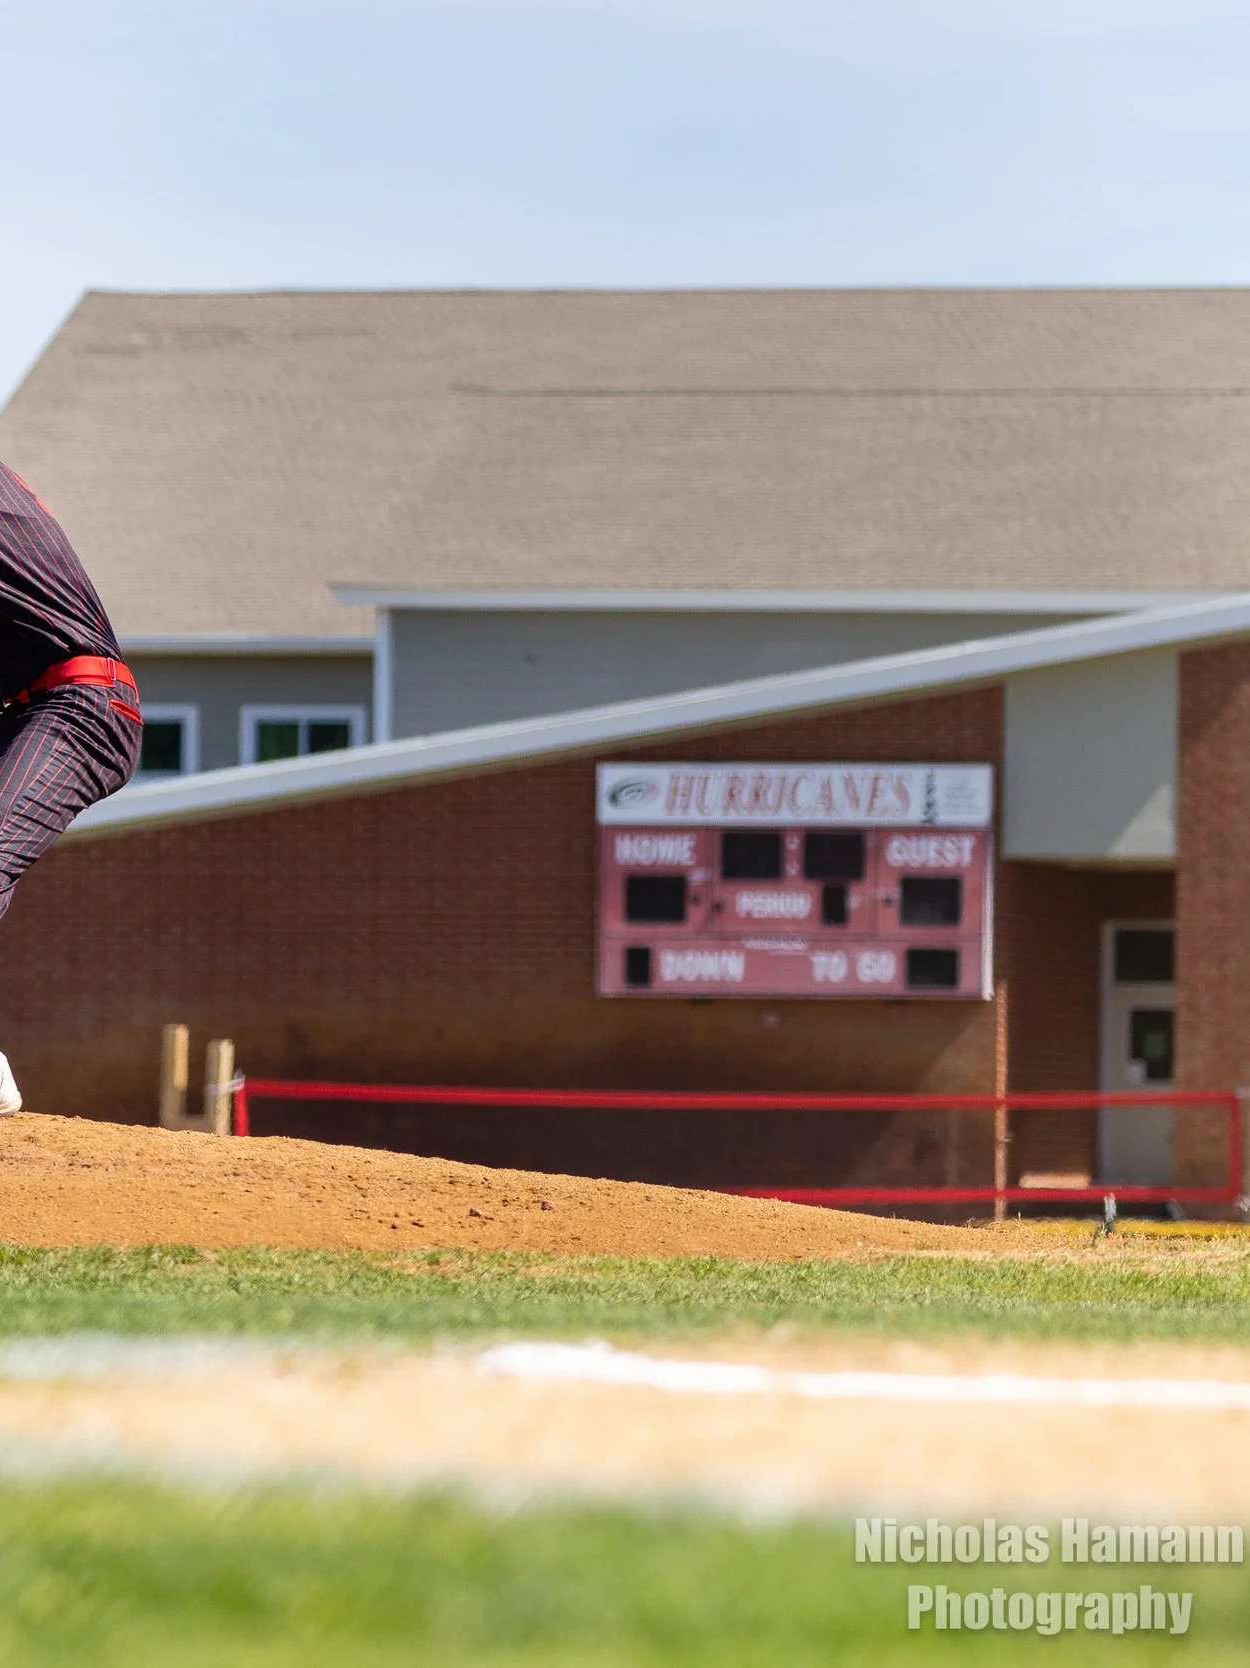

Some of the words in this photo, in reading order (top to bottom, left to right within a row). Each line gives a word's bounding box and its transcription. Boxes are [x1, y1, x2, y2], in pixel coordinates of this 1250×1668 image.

[662, 771, 914, 816] HURRICANES
[614, 834, 697, 866] HOME
[886, 836, 977, 868] GUEST
[735, 892, 812, 919] PERIOD
[660, 950, 746, 983] DOWN
[812, 951, 848, 983] TO
[856, 951, 897, 984] GO
